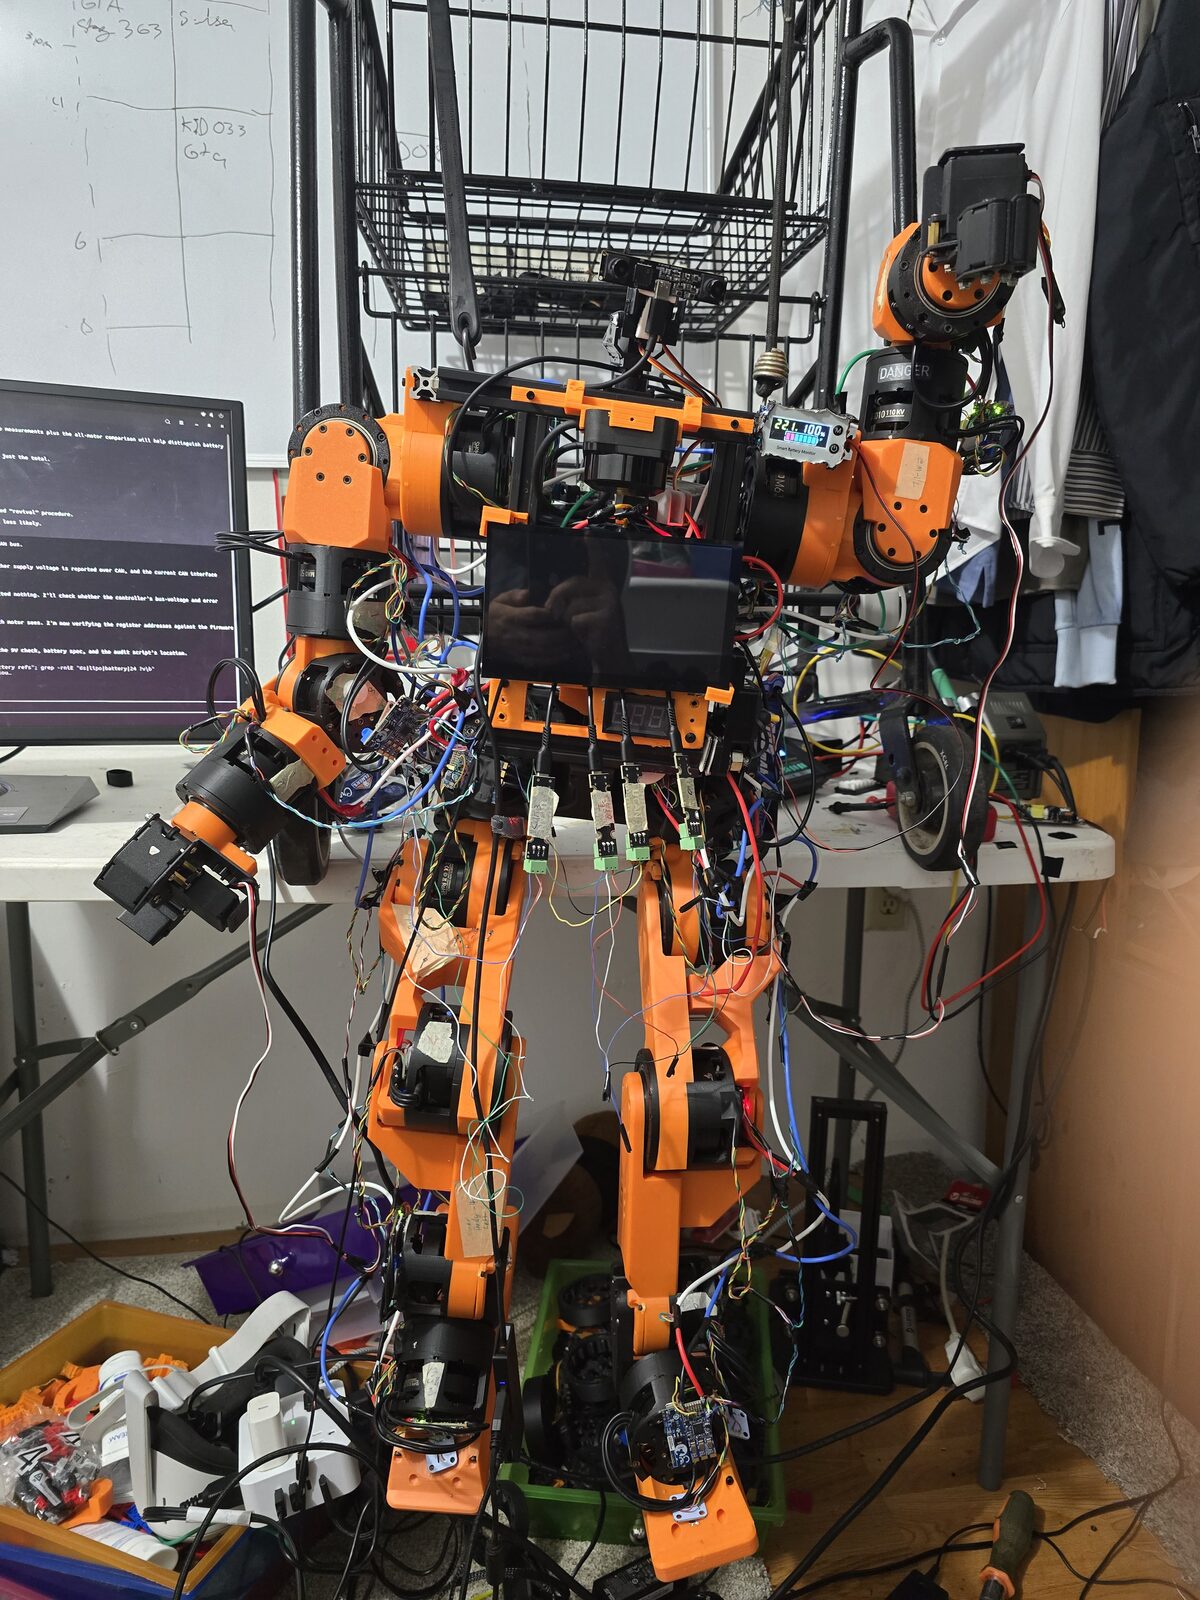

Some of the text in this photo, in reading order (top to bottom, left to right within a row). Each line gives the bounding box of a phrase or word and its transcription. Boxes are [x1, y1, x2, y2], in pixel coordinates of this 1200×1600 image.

[119, 20, 162, 39] 363
[75, 231, 86, 250] 6
[879, 364, 930, 380] DANGER
[203, 441, 224, 450] battery
[18, 1446, 48, 1471] 4
